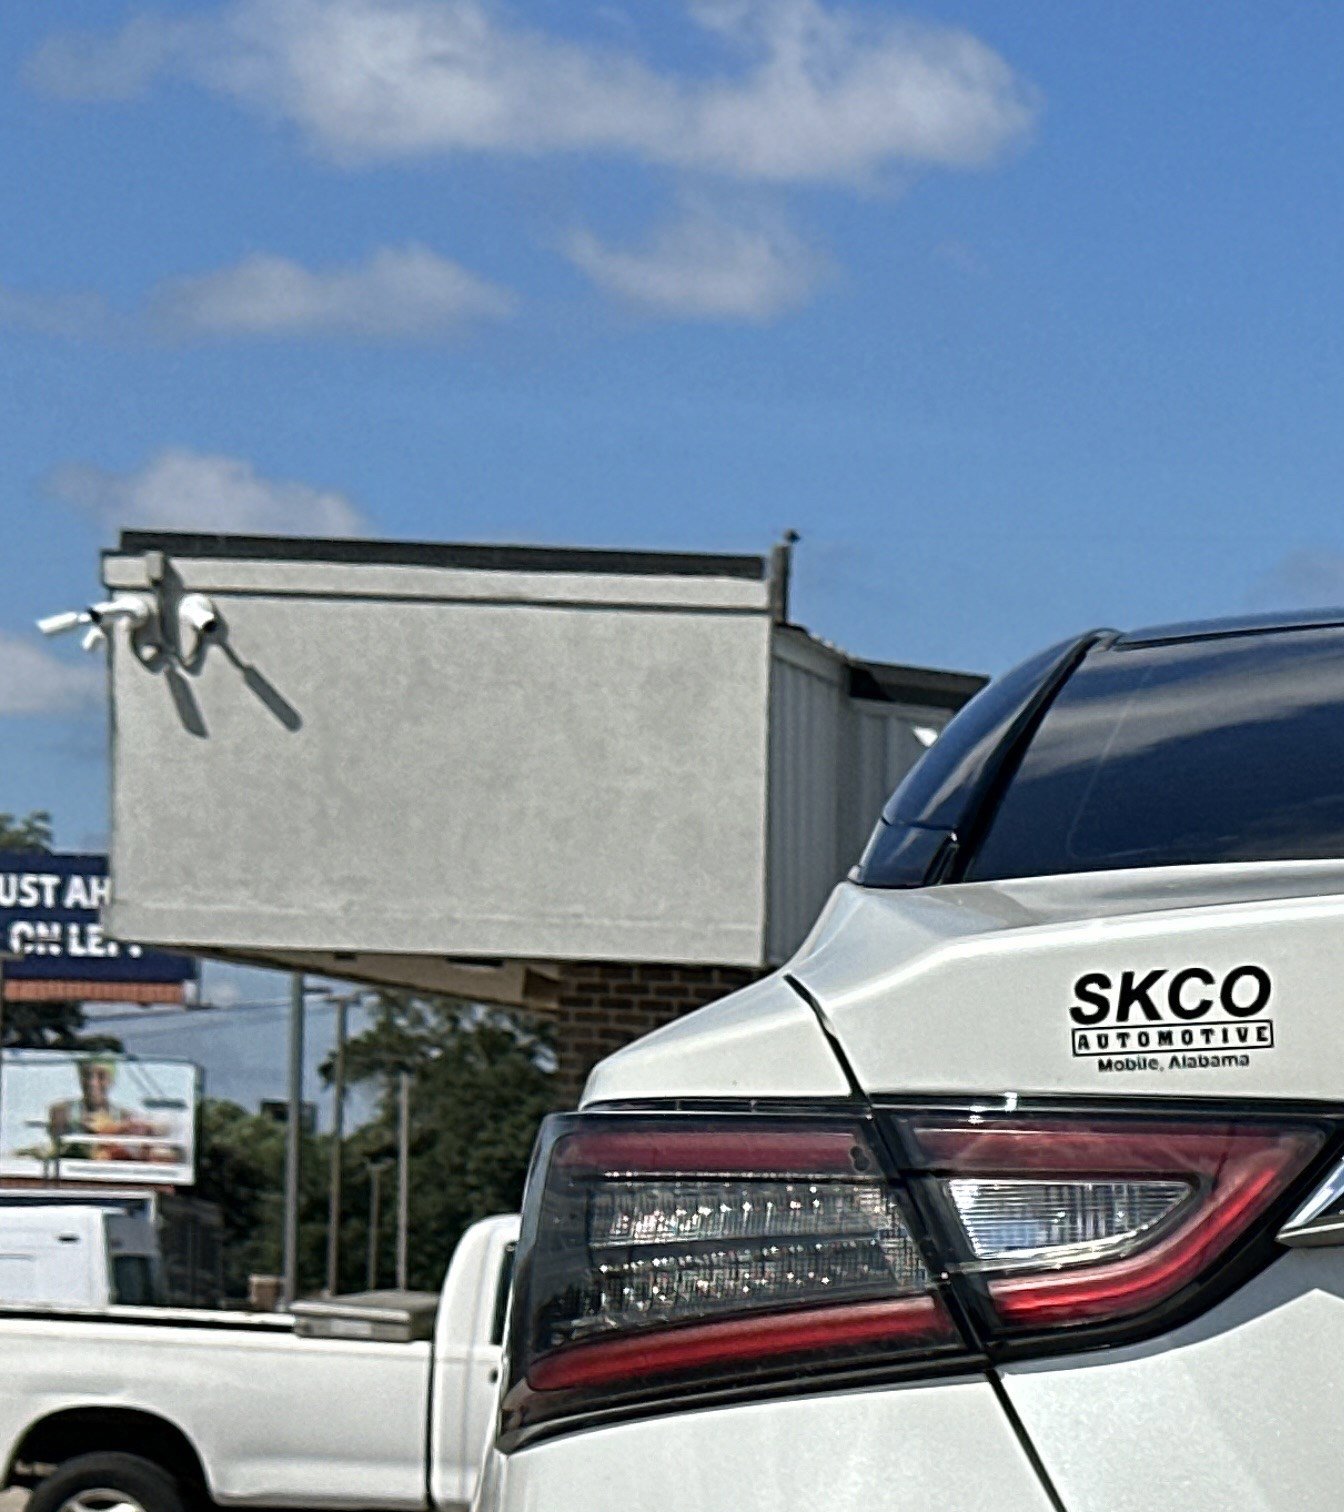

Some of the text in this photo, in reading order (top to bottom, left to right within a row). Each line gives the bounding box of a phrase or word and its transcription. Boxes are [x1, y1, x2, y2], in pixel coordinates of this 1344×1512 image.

[67, 922, 142, 958] LE
[1069, 965, 1271, 1025] SKCO
[1077, 1025, 1269, 1051] AUTOMOTIVE
[1097, 1054, 1250, 1073] Mobile, Alabama
